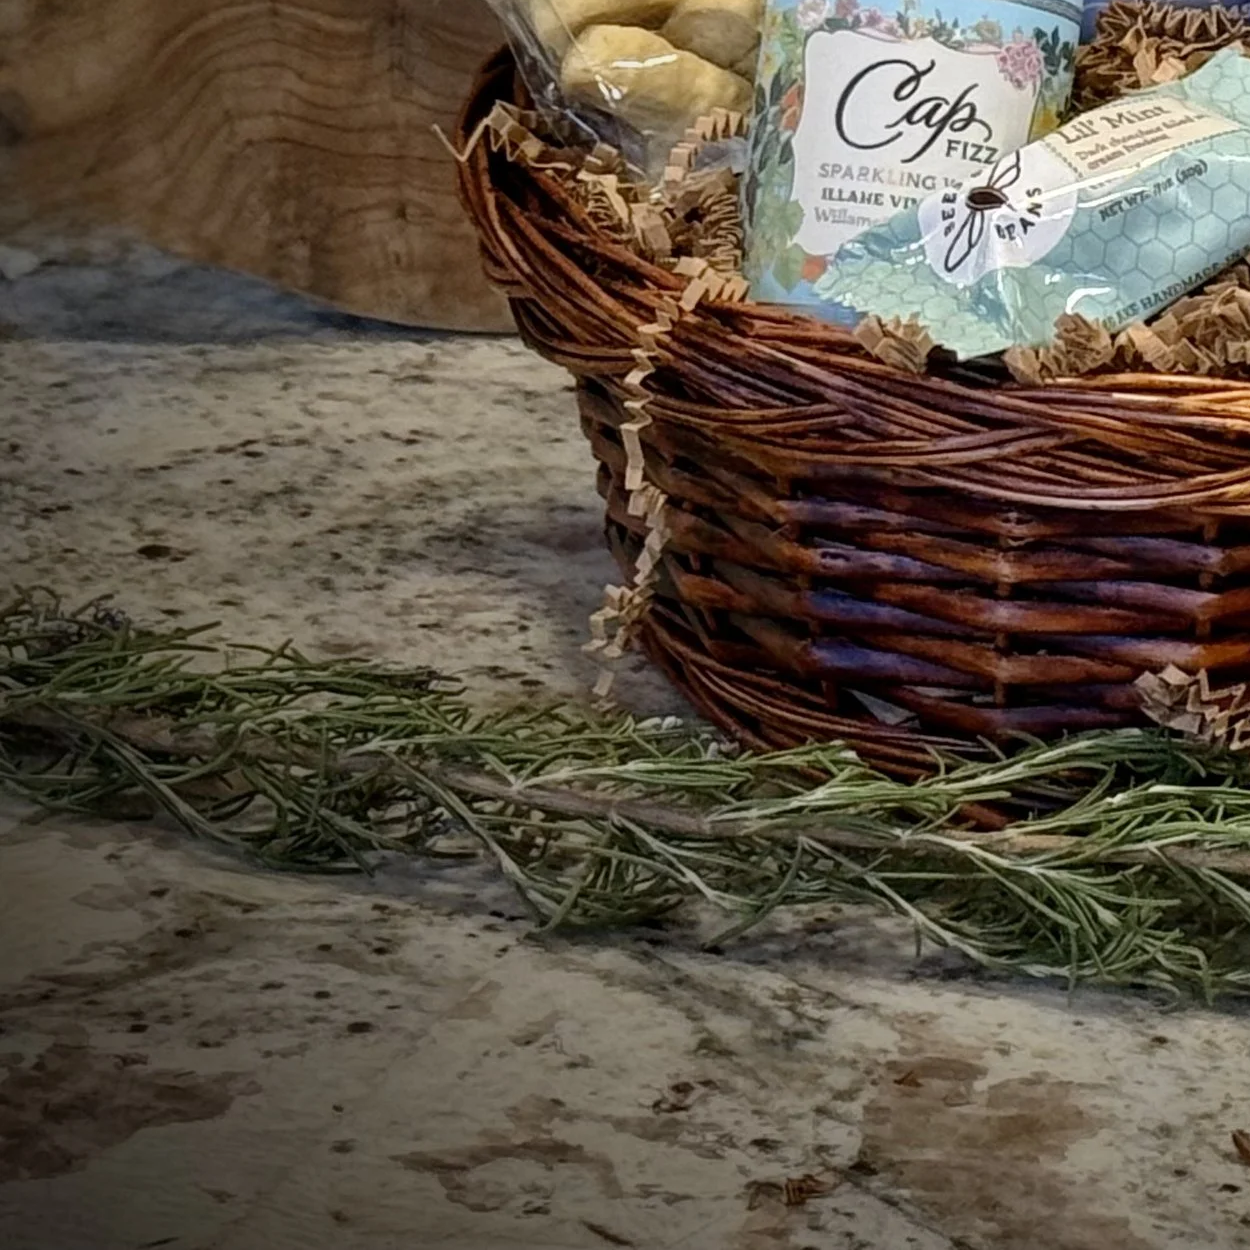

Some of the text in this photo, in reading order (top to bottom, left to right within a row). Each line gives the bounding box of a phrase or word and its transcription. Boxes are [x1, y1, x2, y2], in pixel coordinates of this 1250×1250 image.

[834, 58, 993, 164] Cap
[1057, 105, 1172, 144] Lil' Mint
[945, 138, 999, 166] FIZZ
[817, 162, 938, 191] SPARKLING
[1099, 200, 1126, 222] NET
